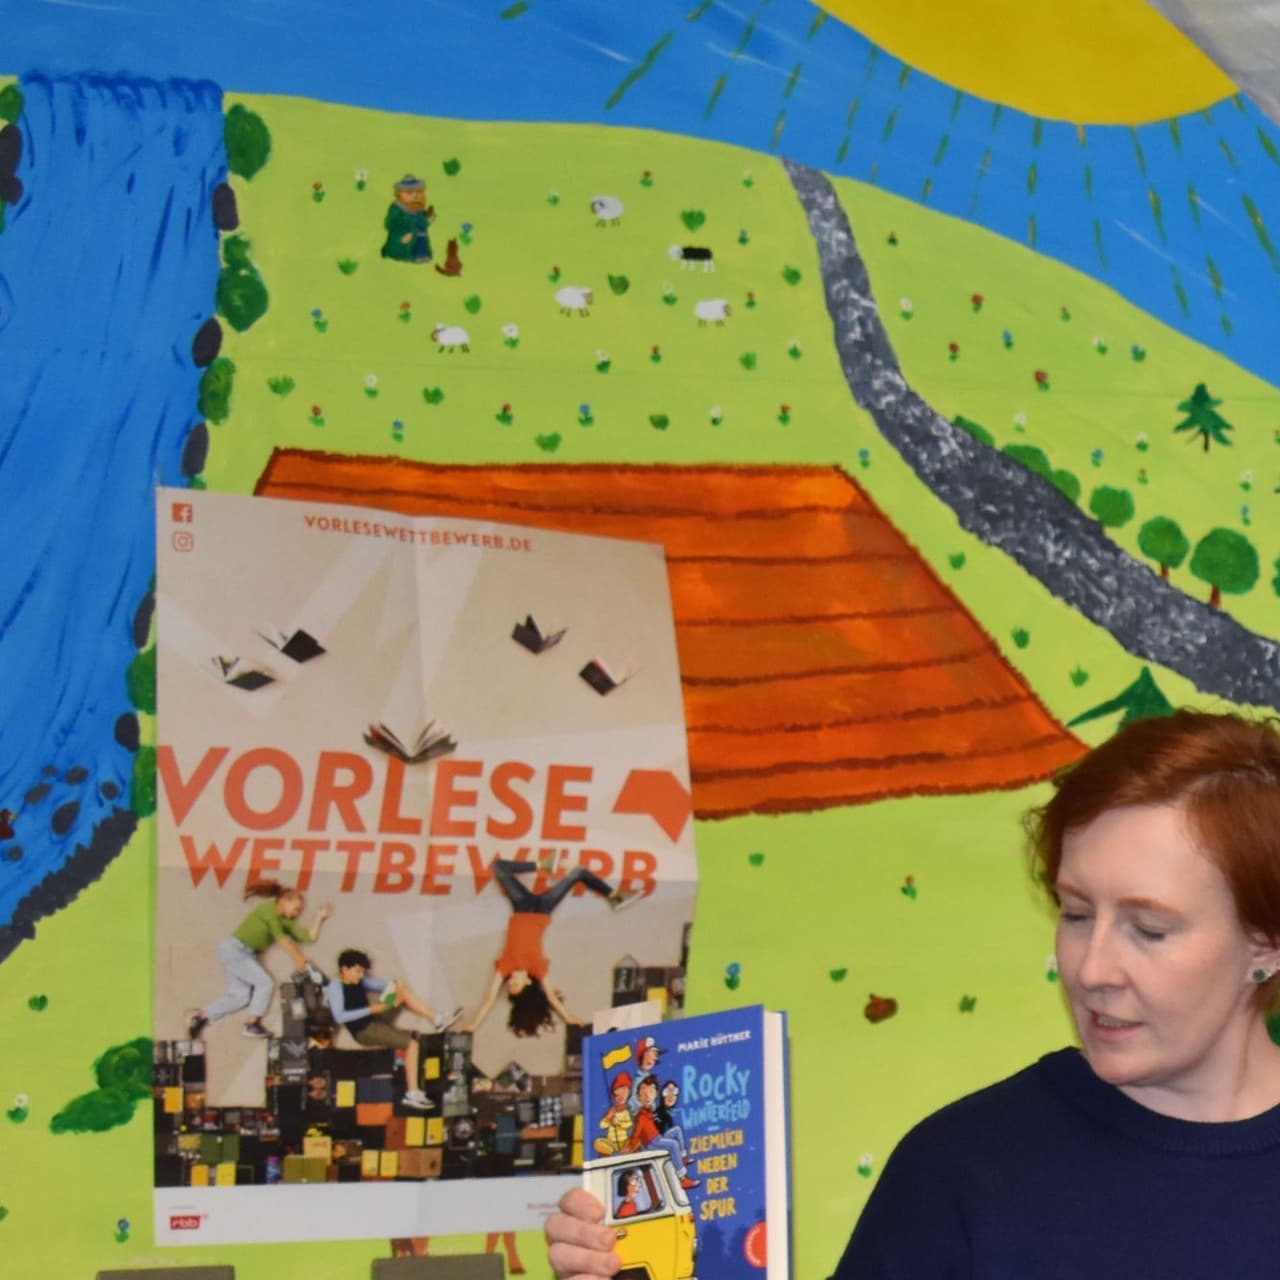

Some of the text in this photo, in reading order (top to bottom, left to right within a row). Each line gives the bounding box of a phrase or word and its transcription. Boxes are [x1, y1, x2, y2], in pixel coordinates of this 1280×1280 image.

[303, 514, 533, 552] VORLESEWETTBEWERB.DE
[156, 744, 593, 842] VORLESE
[689, 1129, 744, 1155] ZIEMLICH
[697, 1153, 738, 1174] NEBEN
[706, 1176, 728, 1195] DER
[700, 1198, 737, 1221] SPUR
